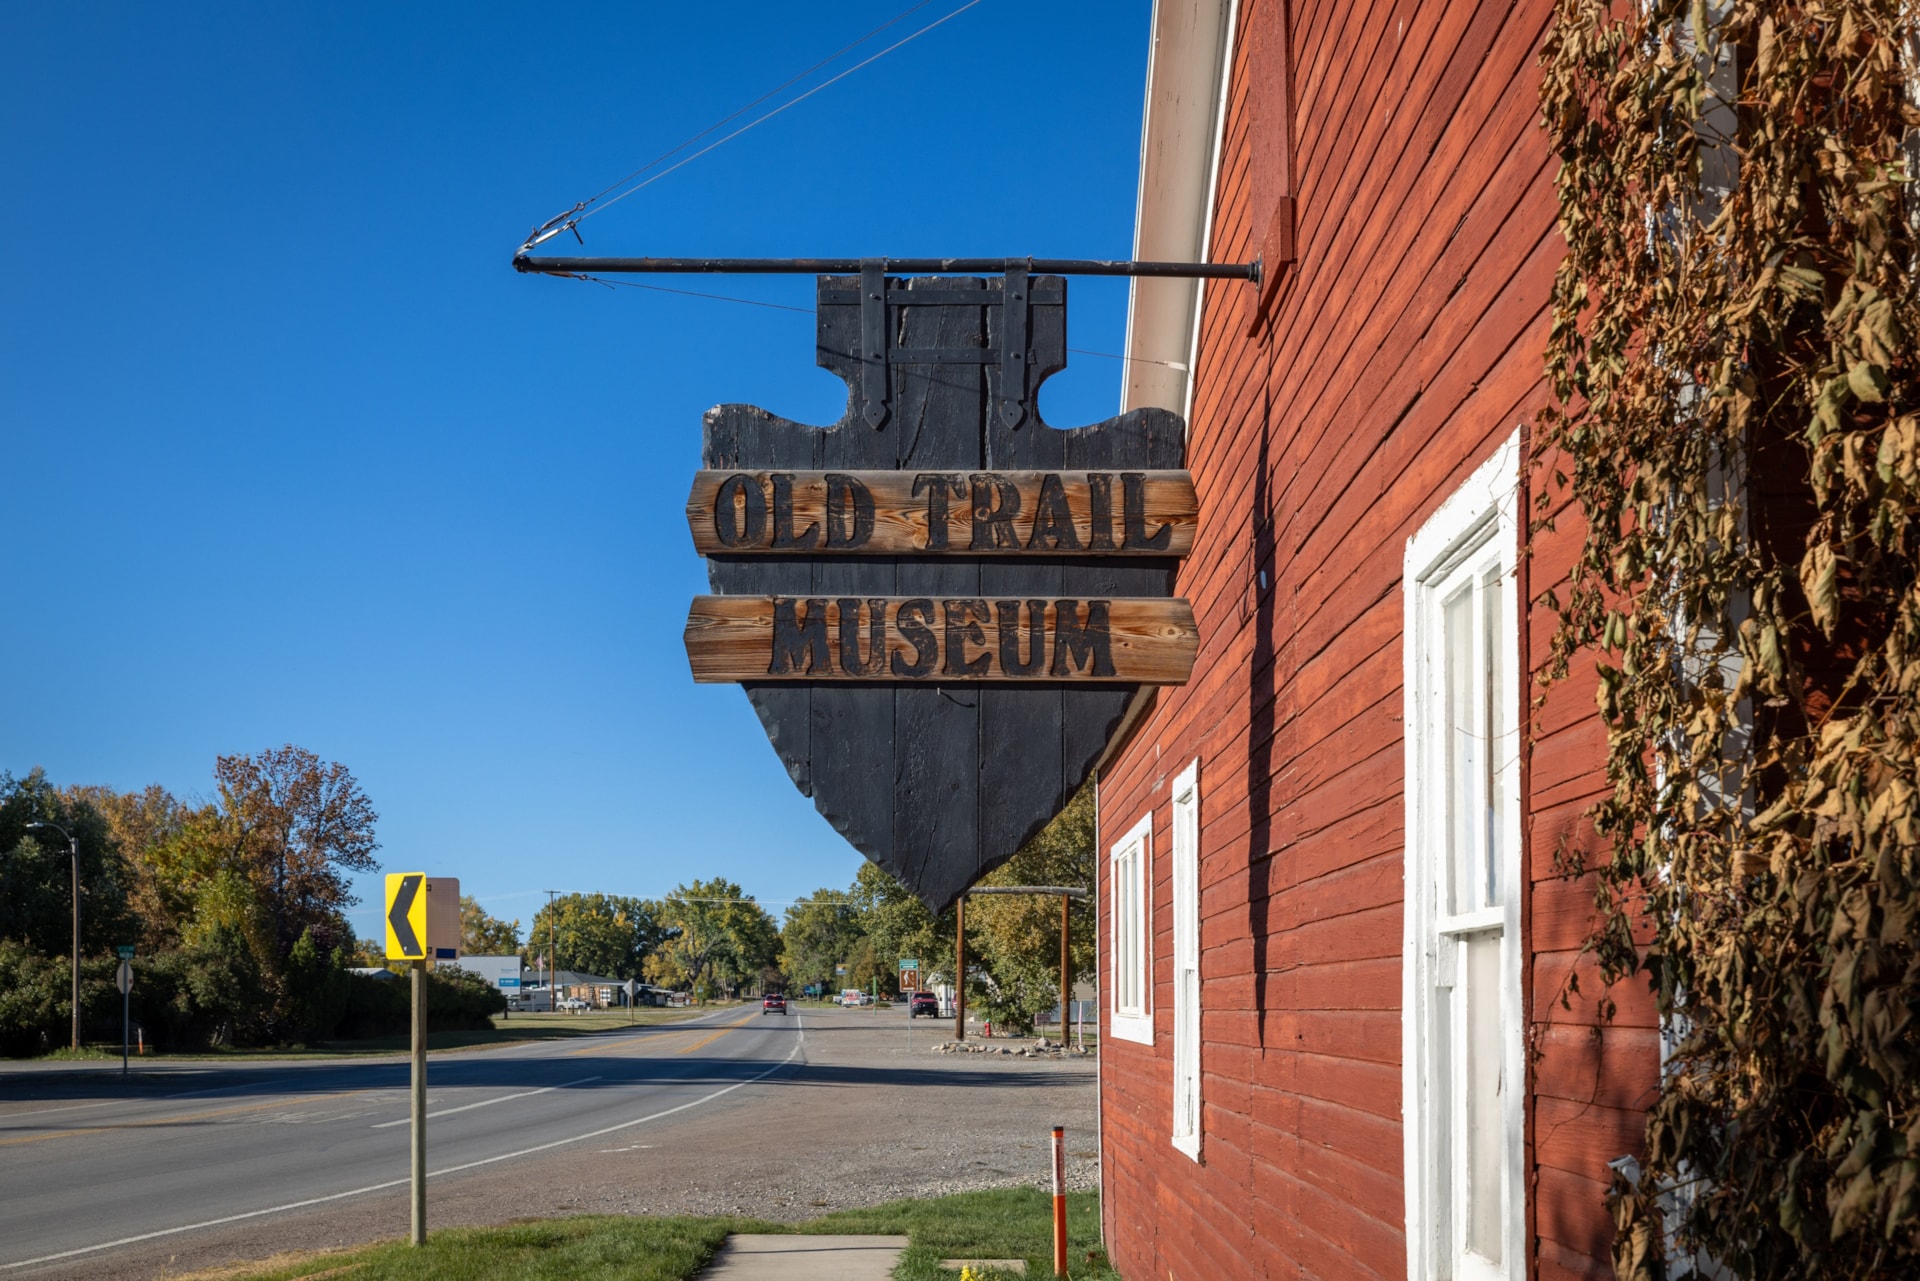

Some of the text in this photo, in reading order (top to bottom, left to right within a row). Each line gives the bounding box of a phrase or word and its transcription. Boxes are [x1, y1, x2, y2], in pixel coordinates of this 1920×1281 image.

[714, 472, 1172, 550] OLD TRAIL
[767, 598, 1117, 678] MUSEUM
